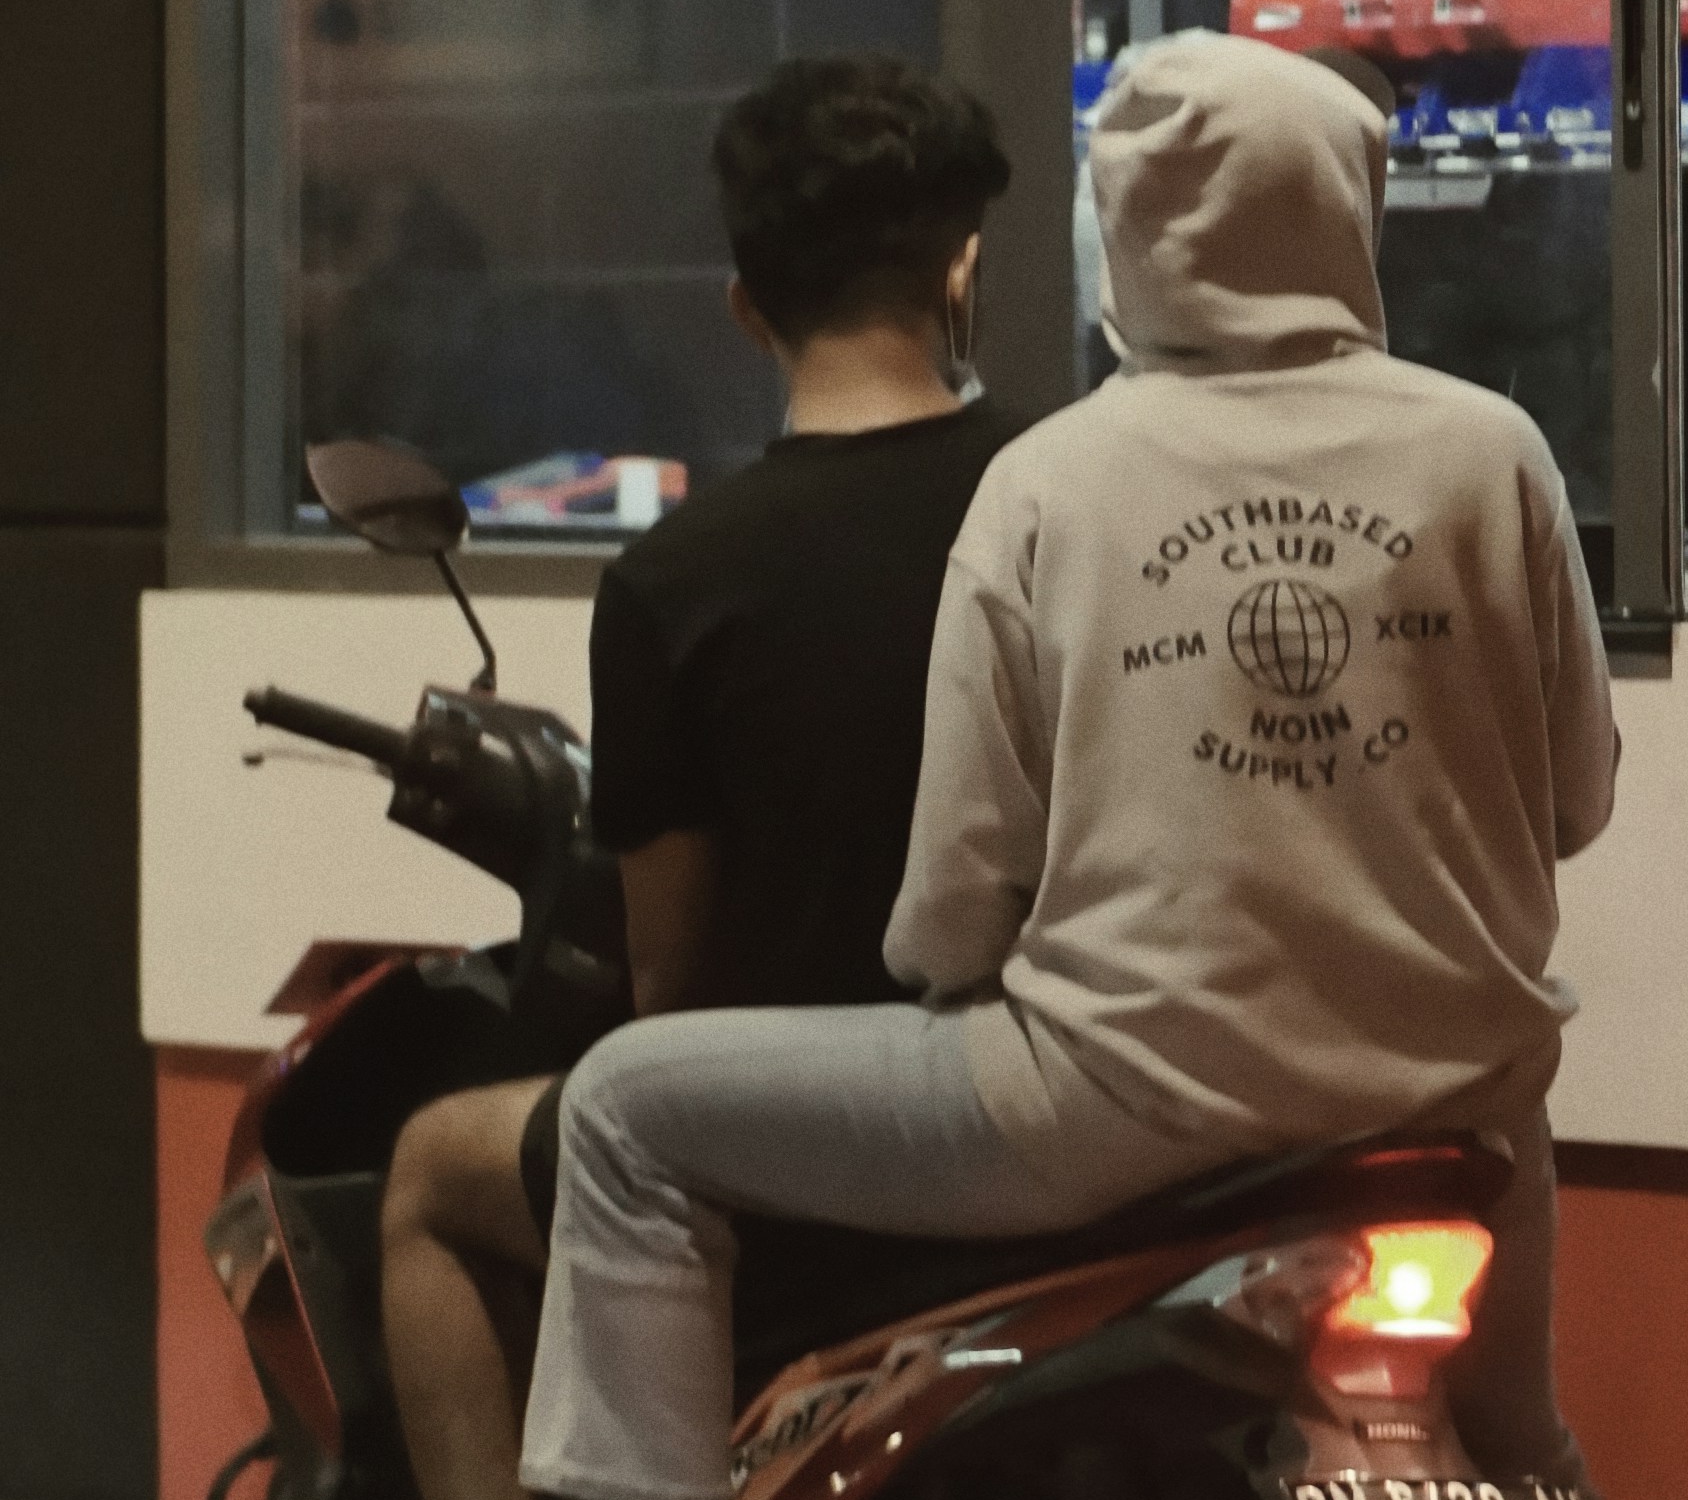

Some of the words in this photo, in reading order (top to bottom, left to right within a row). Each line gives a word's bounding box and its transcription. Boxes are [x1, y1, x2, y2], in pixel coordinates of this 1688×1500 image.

[1141, 497, 1415, 588] SOUTHBASED
[1220, 536, 1336, 573] CLUB
[1122, 630, 1207, 676] MCM
[1374, 609, 1453, 641] XCIX
[1193, 729, 1338, 791] SUPPLY
[1362, 716, 1410, 765] CO
